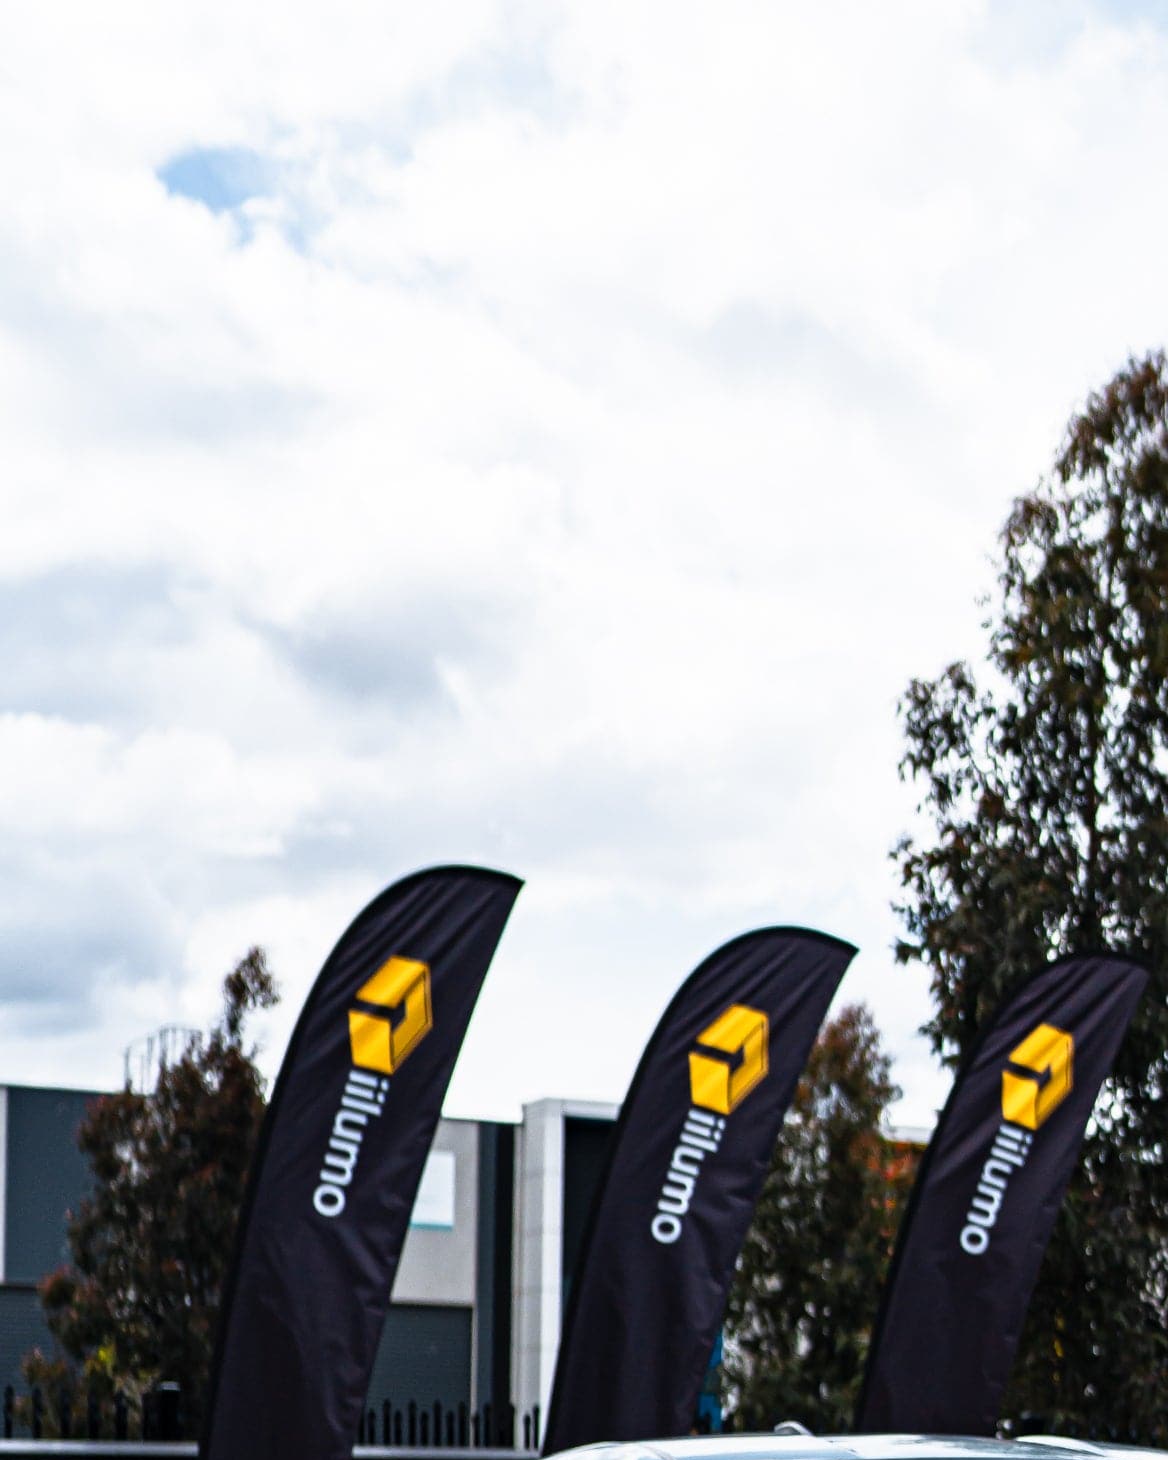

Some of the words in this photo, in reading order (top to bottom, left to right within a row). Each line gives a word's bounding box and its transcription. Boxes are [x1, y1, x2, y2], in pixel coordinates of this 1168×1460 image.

[313, 1070, 389, 1217] iilumo
[651, 1109, 726, 1244] iilumo
[959, 1124, 1033, 1255] iilumo
